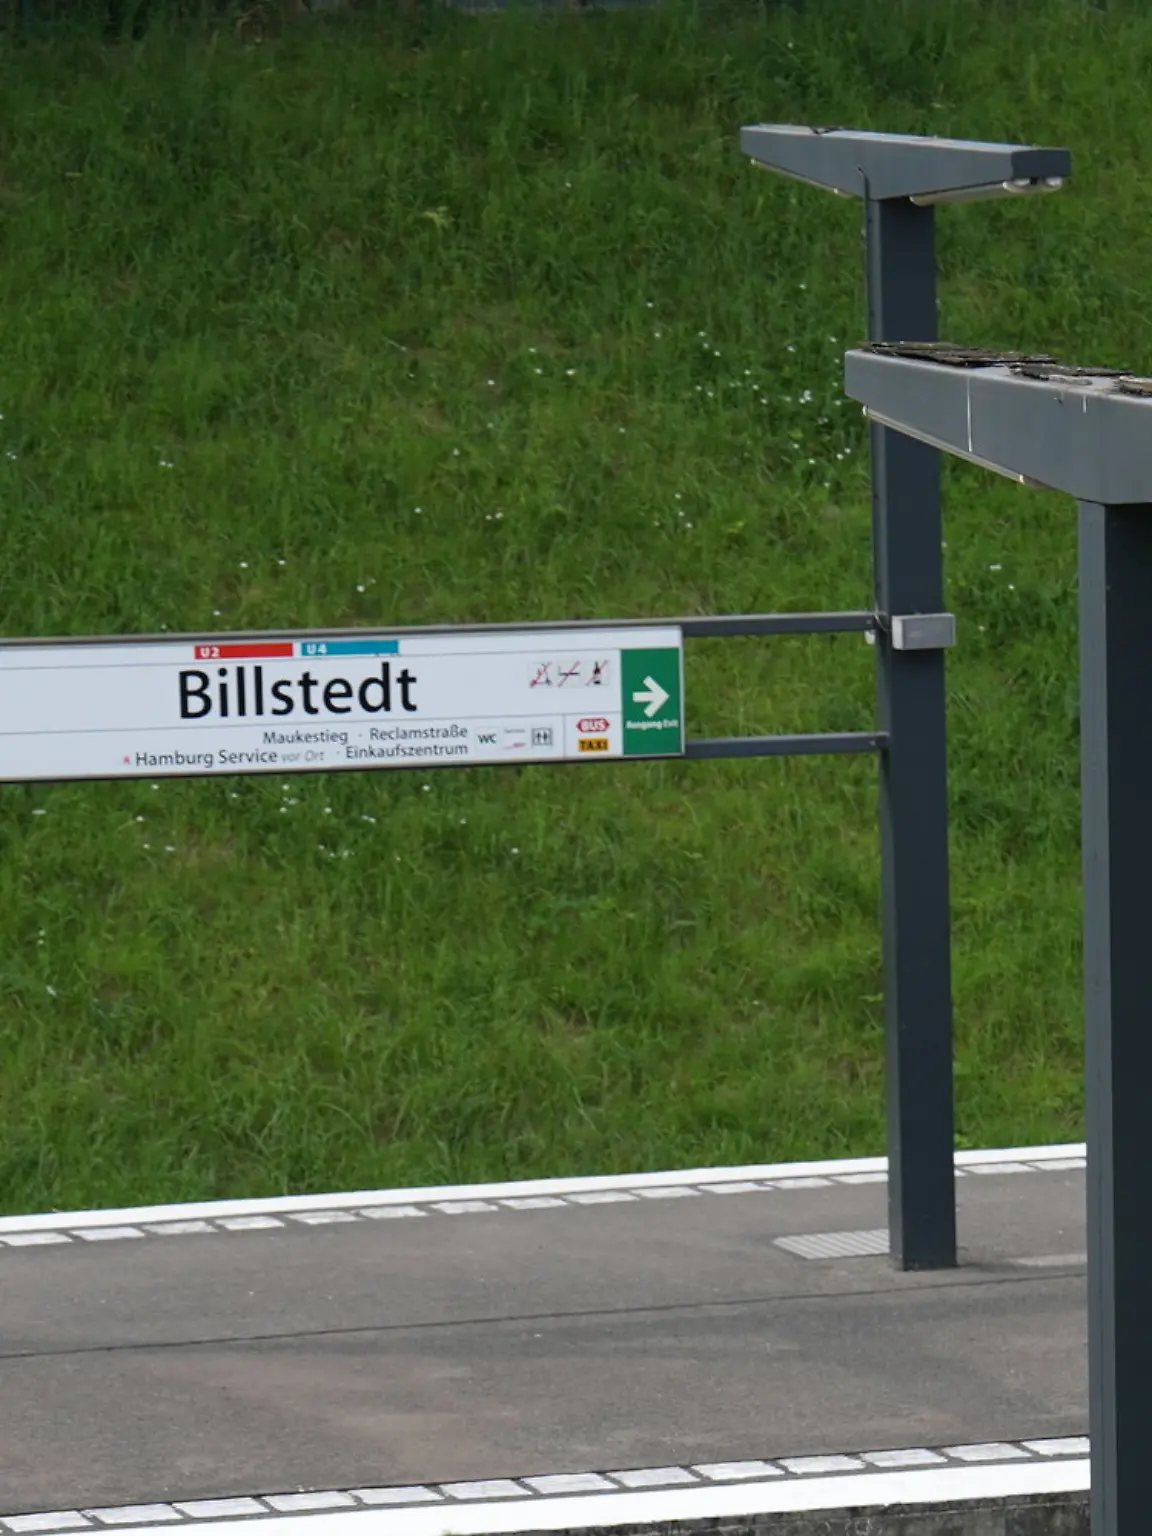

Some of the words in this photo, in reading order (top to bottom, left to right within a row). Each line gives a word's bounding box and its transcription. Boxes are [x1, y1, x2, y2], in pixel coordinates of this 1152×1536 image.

[200, 646, 220, 658] U2
[306, 643, 328, 656] U4
[179, 662, 417, 719] Billstedt
[580, 720, 606, 731] BUS
[263, 730, 348, 745] Maukestieg
[370, 725, 468, 741] Reclamstraße
[478, 734, 497, 745] WC
[579, 739, 608, 751] TAXI
[136, 750, 213, 767] Hamburg
[219, 749, 278, 764] Service
[346, 744, 468, 760] Einkaufszentrum
